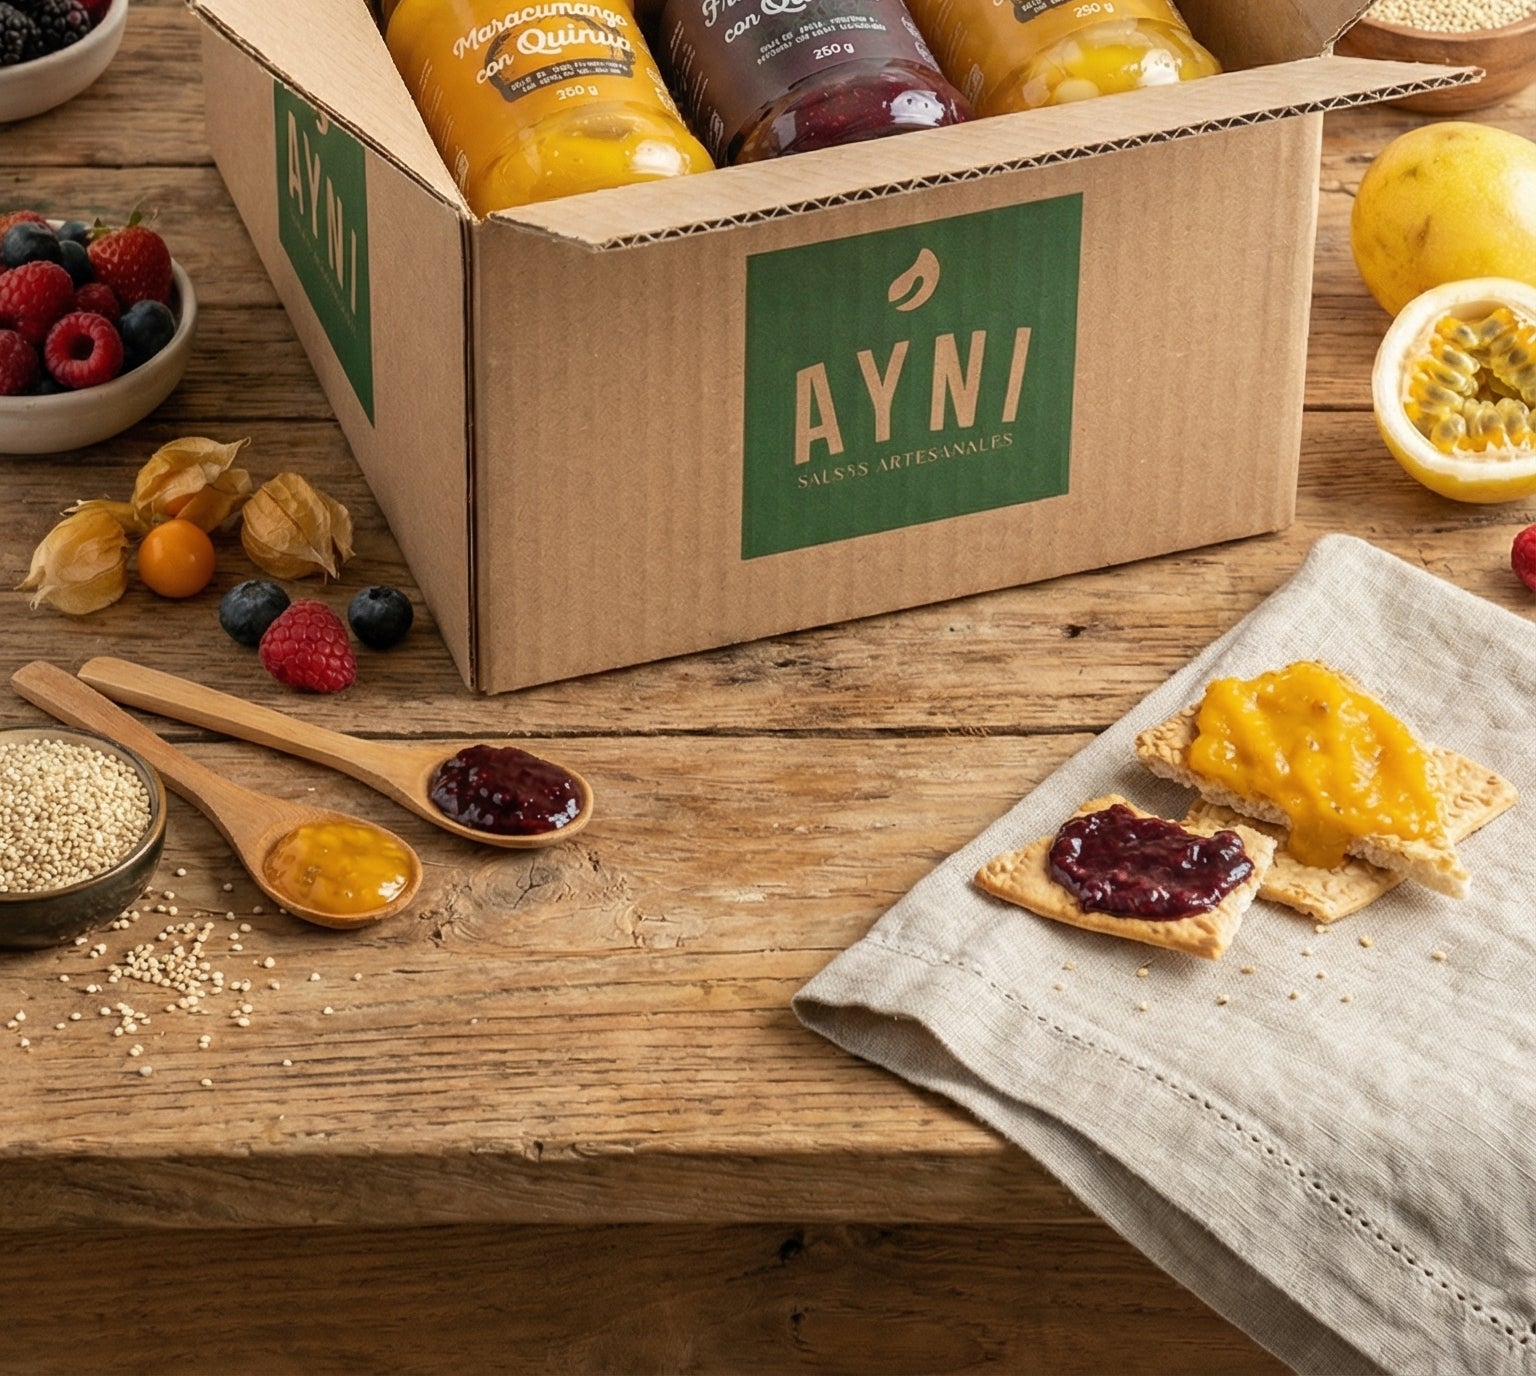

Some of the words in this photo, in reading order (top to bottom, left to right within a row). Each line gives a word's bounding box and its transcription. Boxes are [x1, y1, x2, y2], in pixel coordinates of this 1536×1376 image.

[453, 2, 629, 59] Maracumango
[724, 12, 761, 43] con
[844, 42, 855, 55] g
[476, 52, 515, 84] con
[288, 110, 357, 315] AYNI
[794, 327, 1032, 466] AYNI
